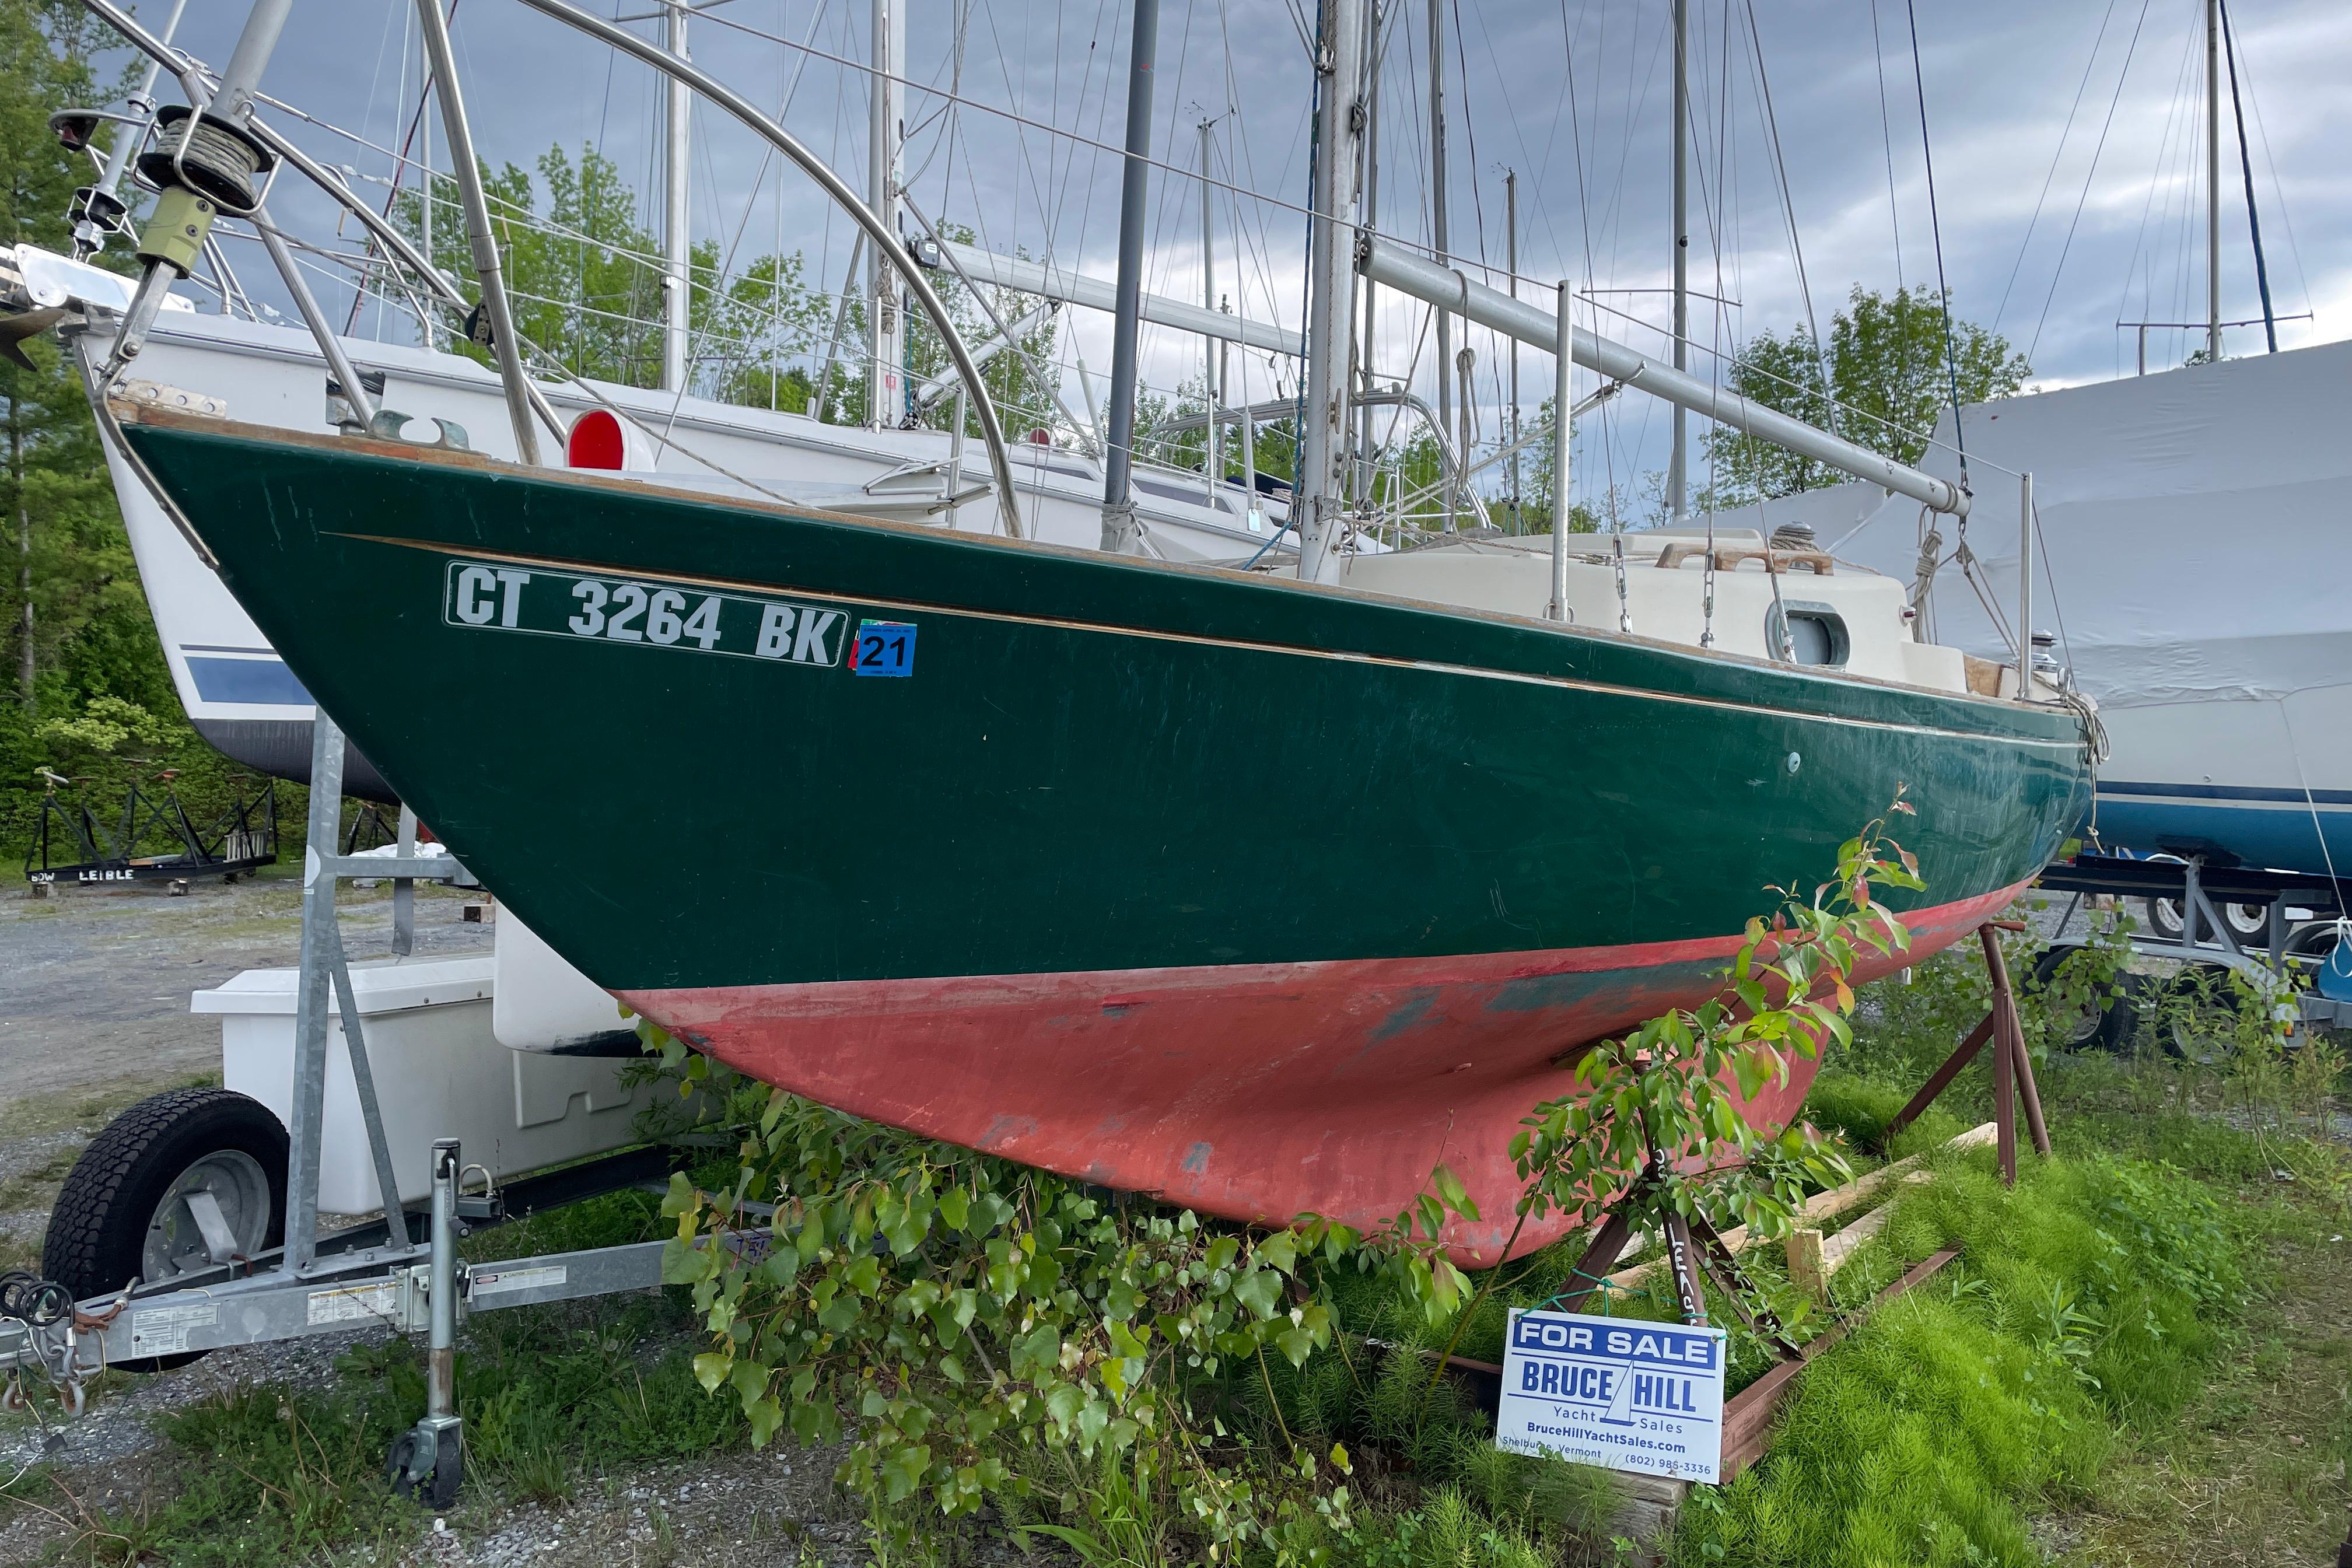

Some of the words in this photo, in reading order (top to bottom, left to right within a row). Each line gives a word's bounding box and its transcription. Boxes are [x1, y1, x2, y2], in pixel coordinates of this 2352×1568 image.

[457, 566, 530, 628] CT
[569, 580, 722, 649] 3264
[755, 604, 838, 664] BK
[861, 636, 905, 666] 21
[79, 869, 134, 881] LEIBLE
[1520, 1322, 1593, 1350] FOR
[1608, 1331, 1709, 1364] SALE
[1522, 1362, 1613, 1401] BRUCE
[1634, 1374, 1696, 1412] HILL
[1554, 1406, 1595, 1422] Yacht
[1640, 1418, 1682, 1434] Sales
[1527, 1422, 1685, 1453] BruceHillYachtSales.com
[1559, 1444, 1601, 1458] Vermont
[1625, 1454, 1654, 1467] (802)
